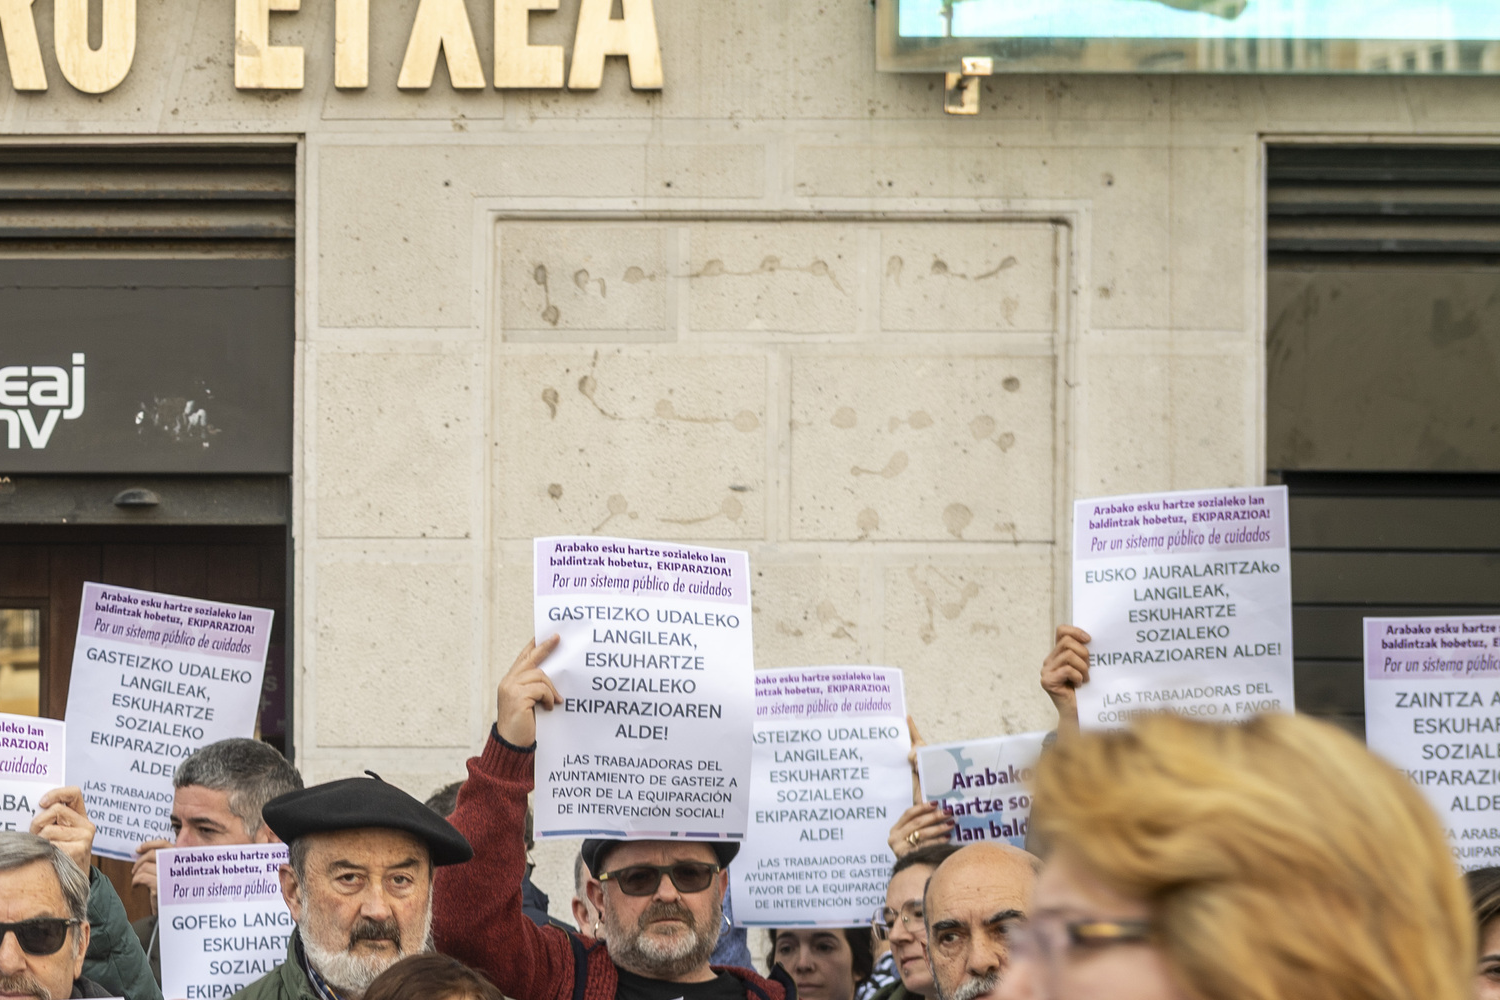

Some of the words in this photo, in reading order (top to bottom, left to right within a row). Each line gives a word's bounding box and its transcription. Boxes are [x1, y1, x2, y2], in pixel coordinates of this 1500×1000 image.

[554, 542, 599, 553] Arabako
[601, 544, 626, 554] esku
[627, 545, 660, 557] hartze
[662, 549, 709, 562] sozialeko
[710, 553, 726, 564] lan
[550, 555, 605, 566] baldintzak
[607, 557, 652, 571] hobetuz,
[657, 561, 732, 577] EKIPARAZIOA!
[1085, 567, 1137, 583] EUSKO
[1143, 560, 1281, 580] JAURALARITZAko
[552, 573, 571, 589] Por
[573, 576, 587, 588] un
[590, 573, 630, 589] sistema
[632, 574, 670, 593] público
[672, 576, 686, 593] de
[688, 580, 732, 597] cuidados
[1134, 583, 1230, 601] LANGILEAK,
[548, 606, 650, 622] GASTEIZKO
[656, 609, 740, 629] UDALEKO
[1128, 603, 1236, 623] ESKUHARTZE
[593, 629, 697, 649] LANGILEAK,
[1136, 625, 1230, 643] SOZIALEKO
[1233, 642, 1281, 658] ALDE!
[585, 652, 704, 671] ESKUHARTZE
[591, 676, 696, 694] SOZIALEKO
[564, 698, 722, 719] EKIPARAZIOAREN
[615, 724, 668, 741] ALDE!
[563, 754, 590, 768] ¡LAS
[594, 755, 693, 771] TRABAJADORAS
[697, 760, 723, 772] DEL
[548, 770, 645, 785] AYUNTAMIENTO
[649, 775, 667, 786] DE
[671, 775, 725, 788] GASTEIZ
[728, 777, 738, 788] A
[552, 787, 592, 798] FAVOR
[595, 787, 613, 799] DE
[617, 789, 634, 800] LA
[637, 790, 732, 803] EQUIPARACIÓN
[557, 803, 573, 815] DE
[577, 803, 671, 818] INTERVENCIÓN
[675, 807, 725, 819] SOCIAL!
